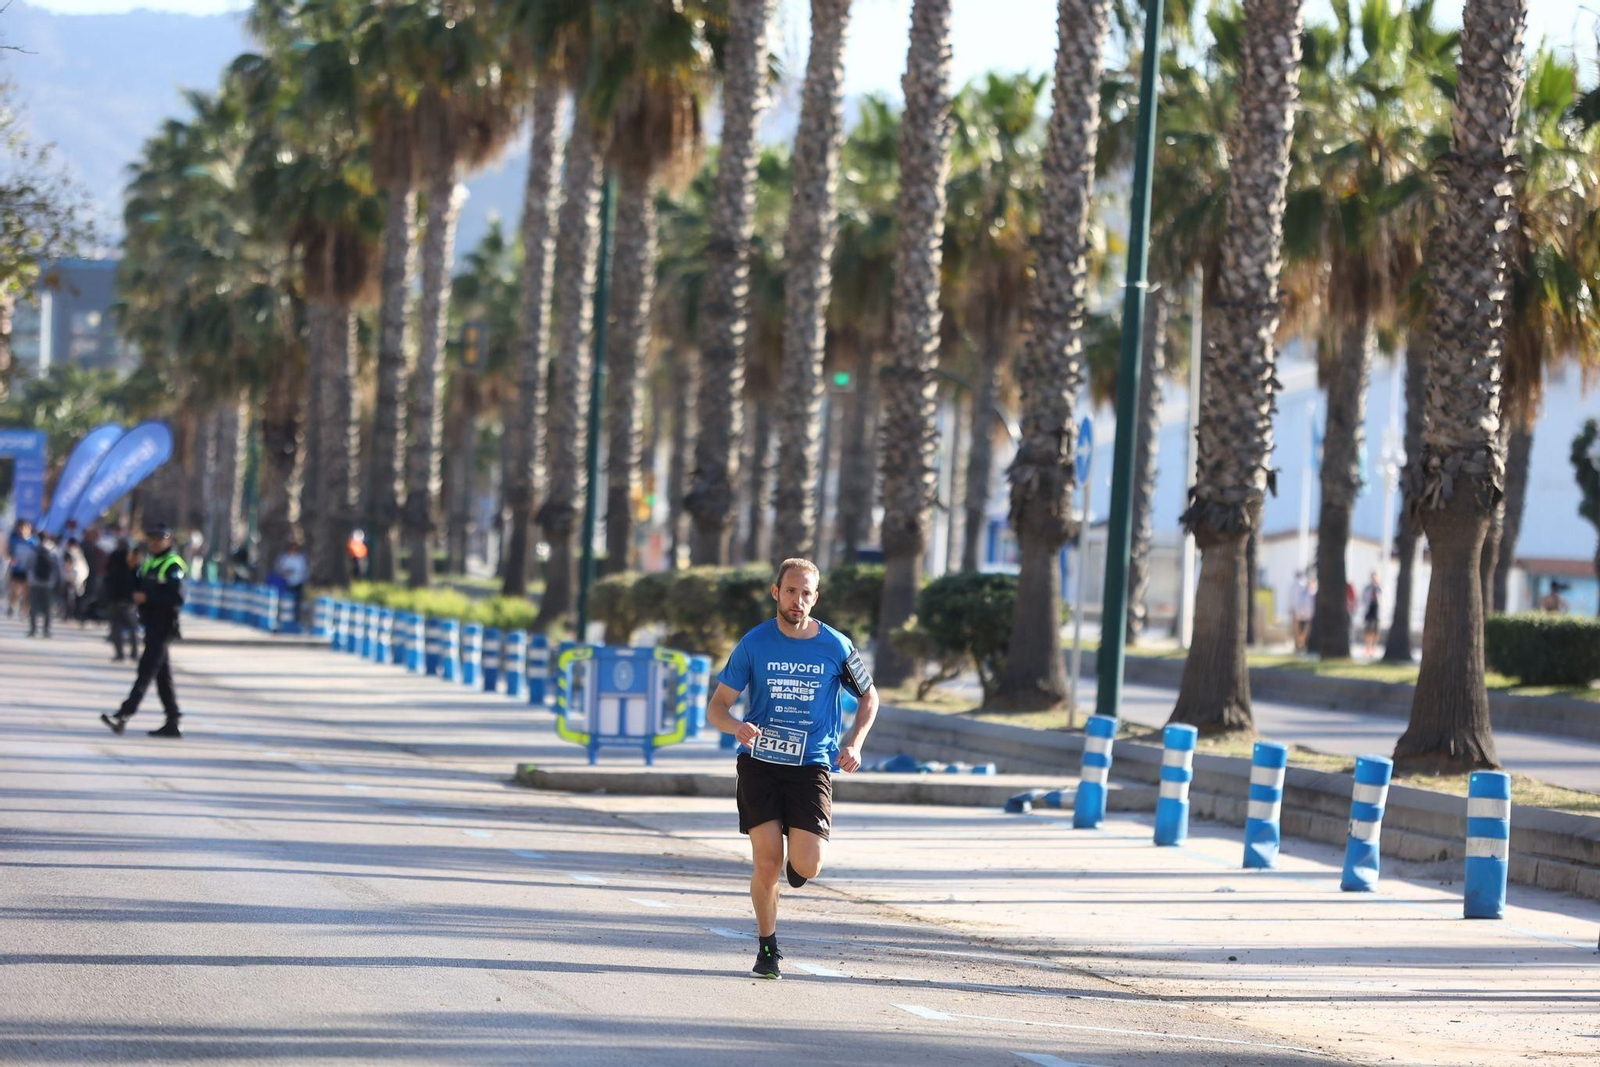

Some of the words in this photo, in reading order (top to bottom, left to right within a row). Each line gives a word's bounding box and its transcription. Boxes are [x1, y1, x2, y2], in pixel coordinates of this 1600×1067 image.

[767, 661, 825, 675] mayoral
[766, 678, 820, 688] RUNNING
[772, 685, 815, 695] MAKES
[770, 692, 815, 702] FRIENDS
[759, 737, 797, 754] 2141
